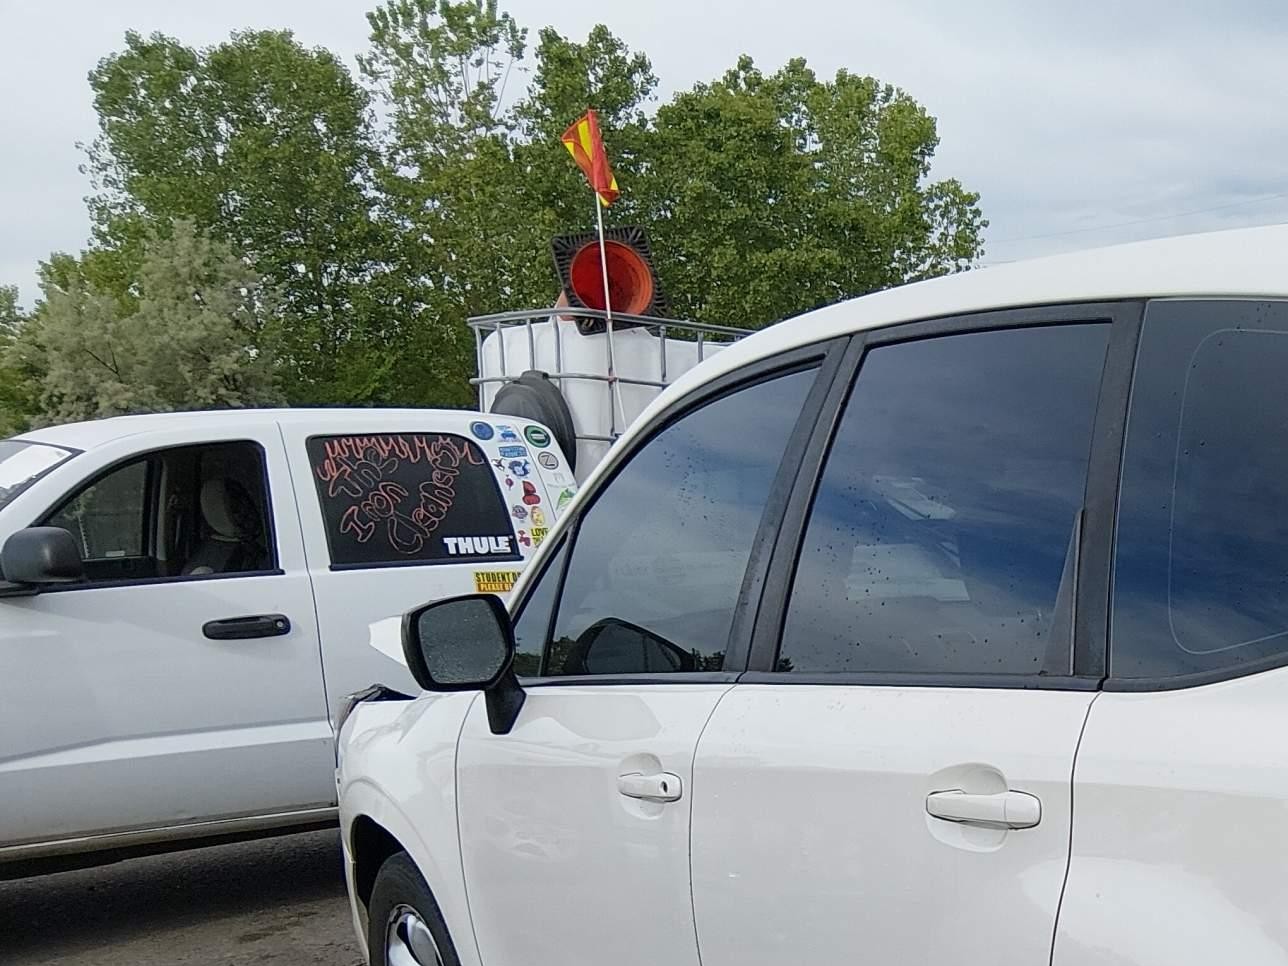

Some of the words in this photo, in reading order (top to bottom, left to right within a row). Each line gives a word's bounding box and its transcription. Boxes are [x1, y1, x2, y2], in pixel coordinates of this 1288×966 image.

[340, 481, 409, 543] Iron
[443, 535, 512, 554] THULE
[475, 571, 510, 583] STUDENT
